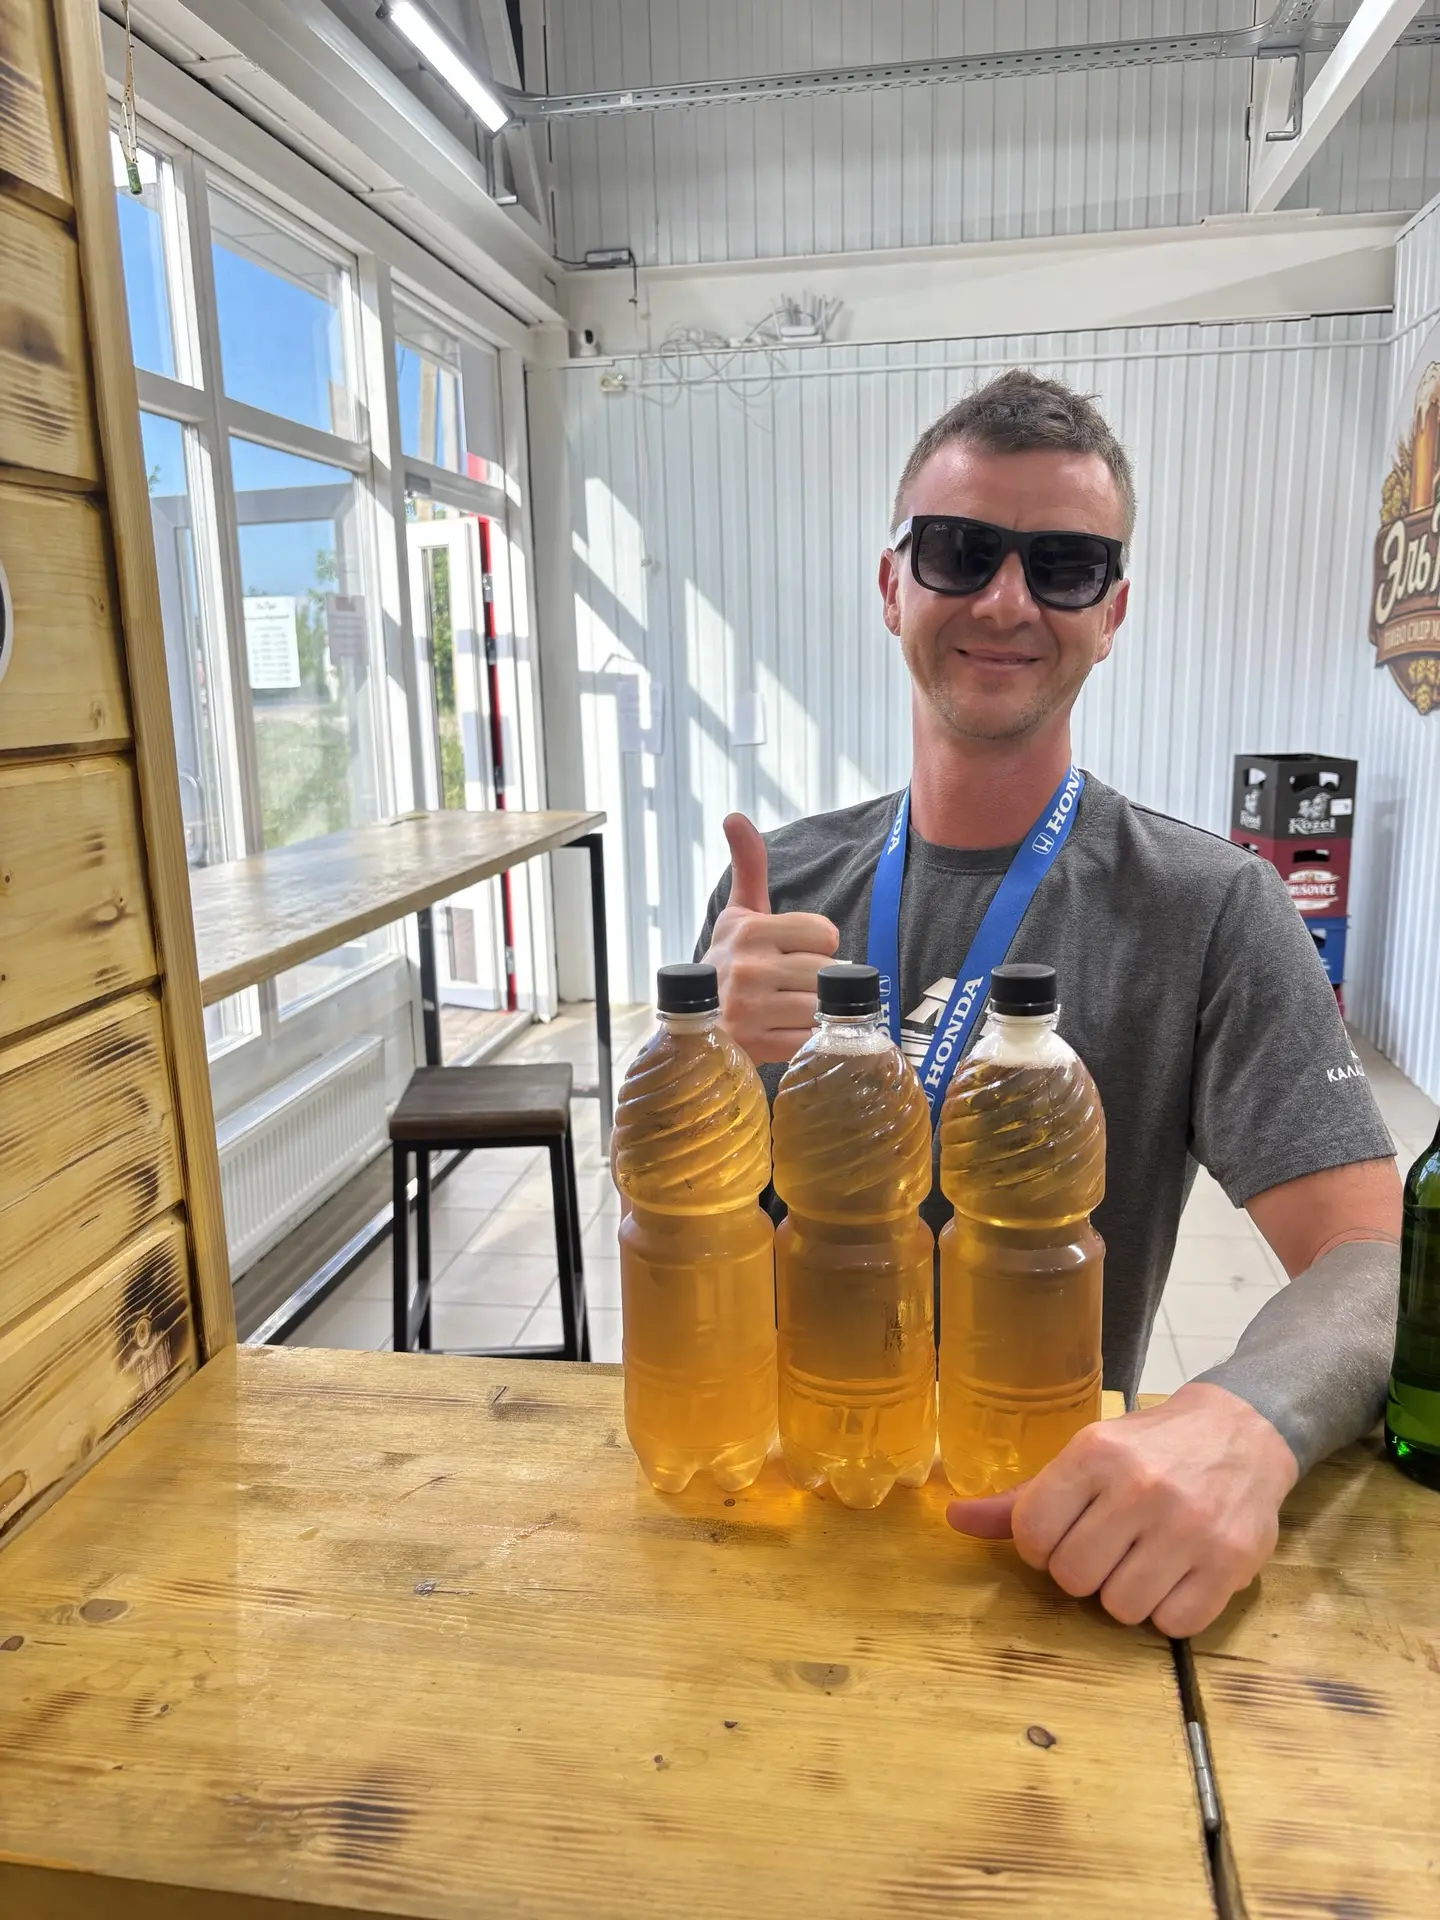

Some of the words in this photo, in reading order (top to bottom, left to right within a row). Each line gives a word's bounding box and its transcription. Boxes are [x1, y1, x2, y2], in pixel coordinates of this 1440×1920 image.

[1375, 520, 1431, 624] Эль
[1288, 817, 1337, 835] Kozel
[925, 976, 984, 1089] HONDA
